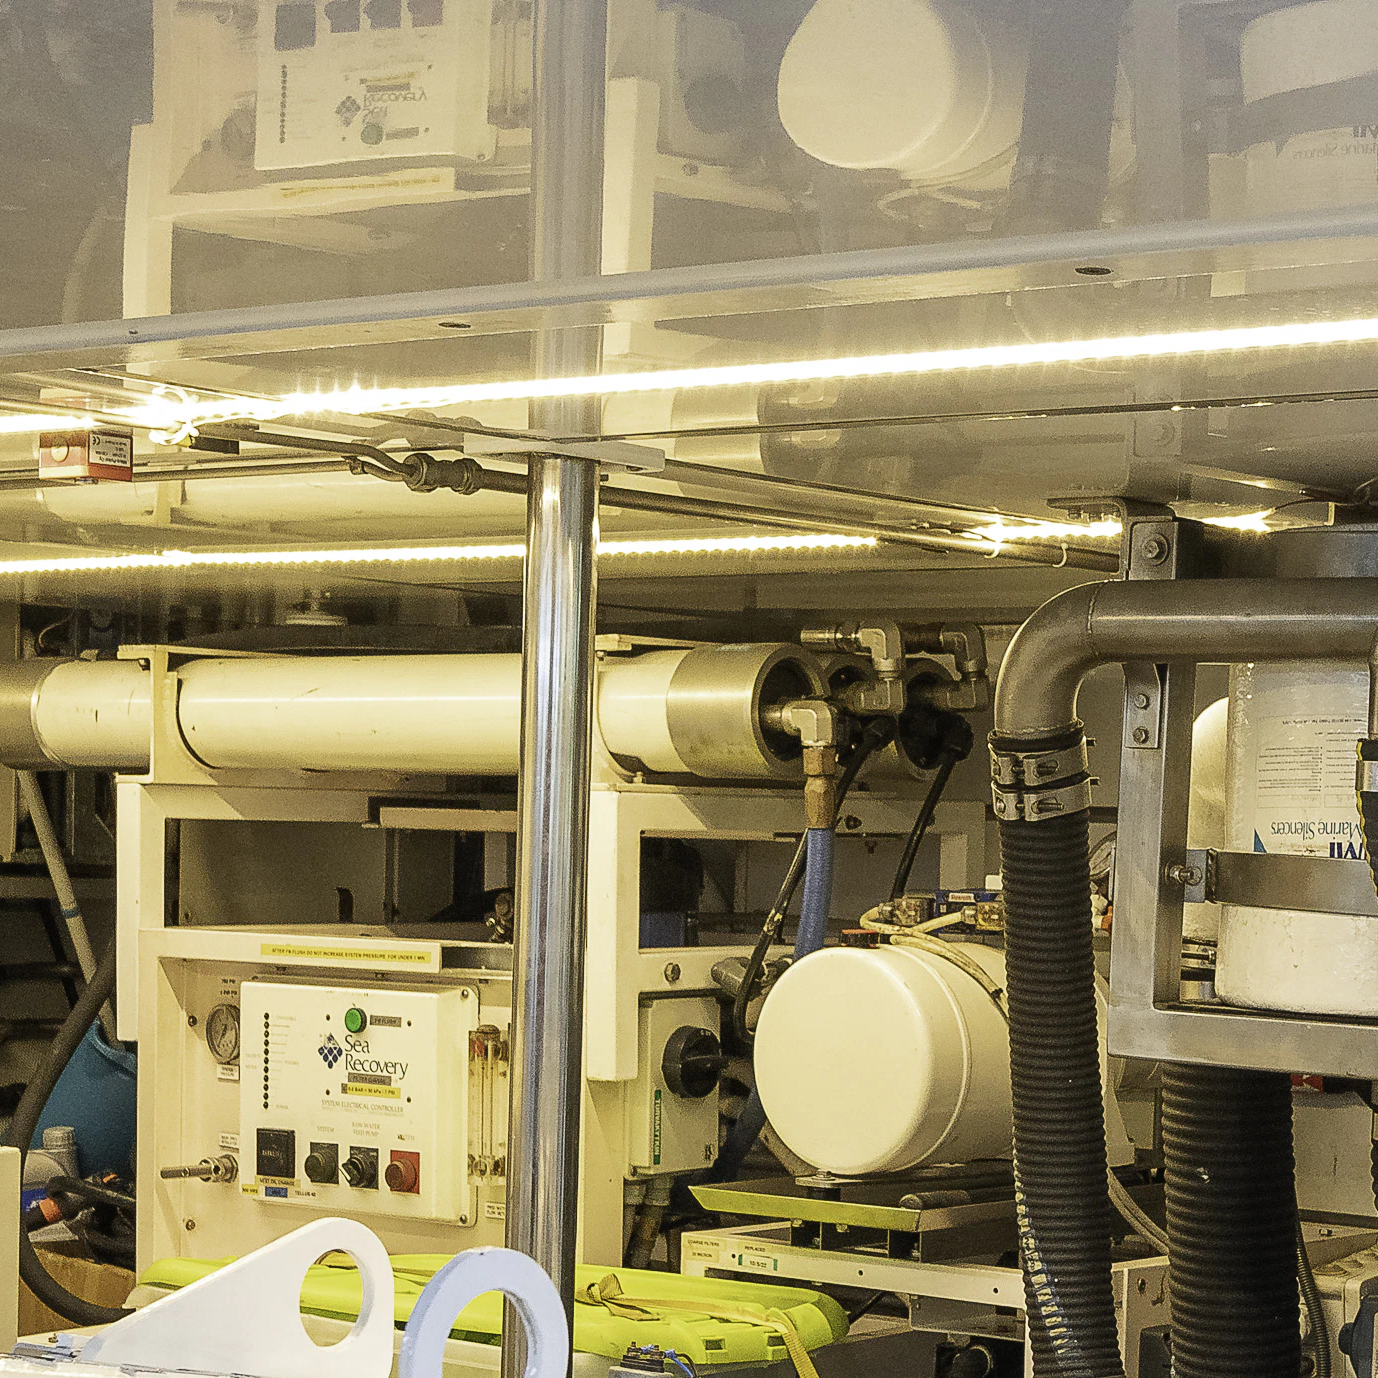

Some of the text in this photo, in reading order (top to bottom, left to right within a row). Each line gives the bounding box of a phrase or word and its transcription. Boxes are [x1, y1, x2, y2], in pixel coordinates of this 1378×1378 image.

[1270, 821, 1362, 842] Marine Silencers
[344, 1034, 370, 1054] Sea
[345, 1053, 409, 1080] Recovery
[321, 1099, 405, 1113] SYSTEM ELECTRICAL CONTROLLER
[744, 1245, 766, 1253] REPLACED
